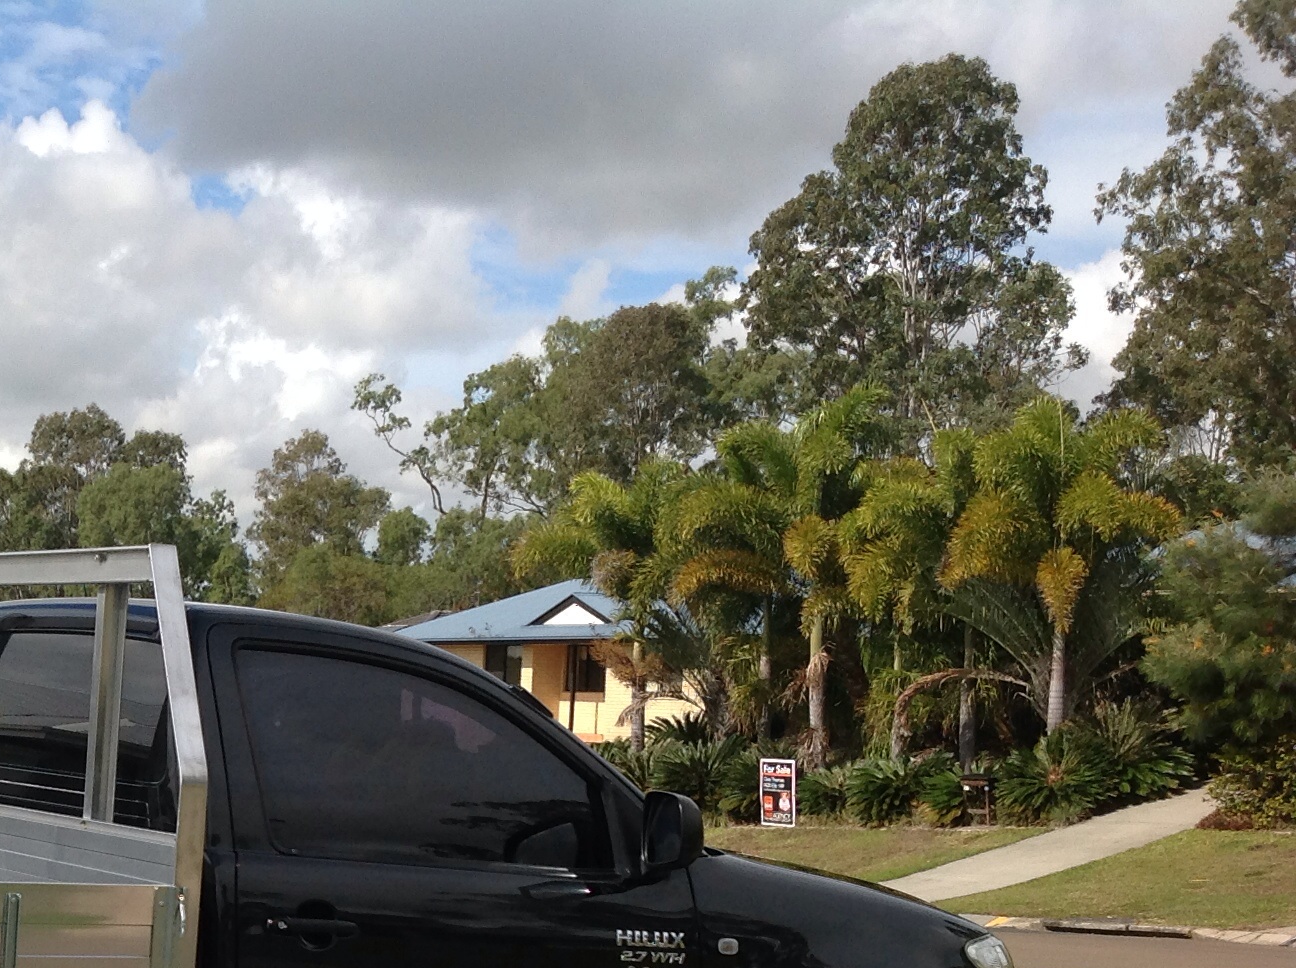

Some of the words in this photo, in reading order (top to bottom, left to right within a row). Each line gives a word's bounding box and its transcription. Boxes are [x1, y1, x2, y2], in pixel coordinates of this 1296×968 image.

[764, 764, 775, 774] For
[776, 765, 791, 775] Sale
[616, 929, 685, 948] HILUX
[620, 950, 648, 962] 2.7
